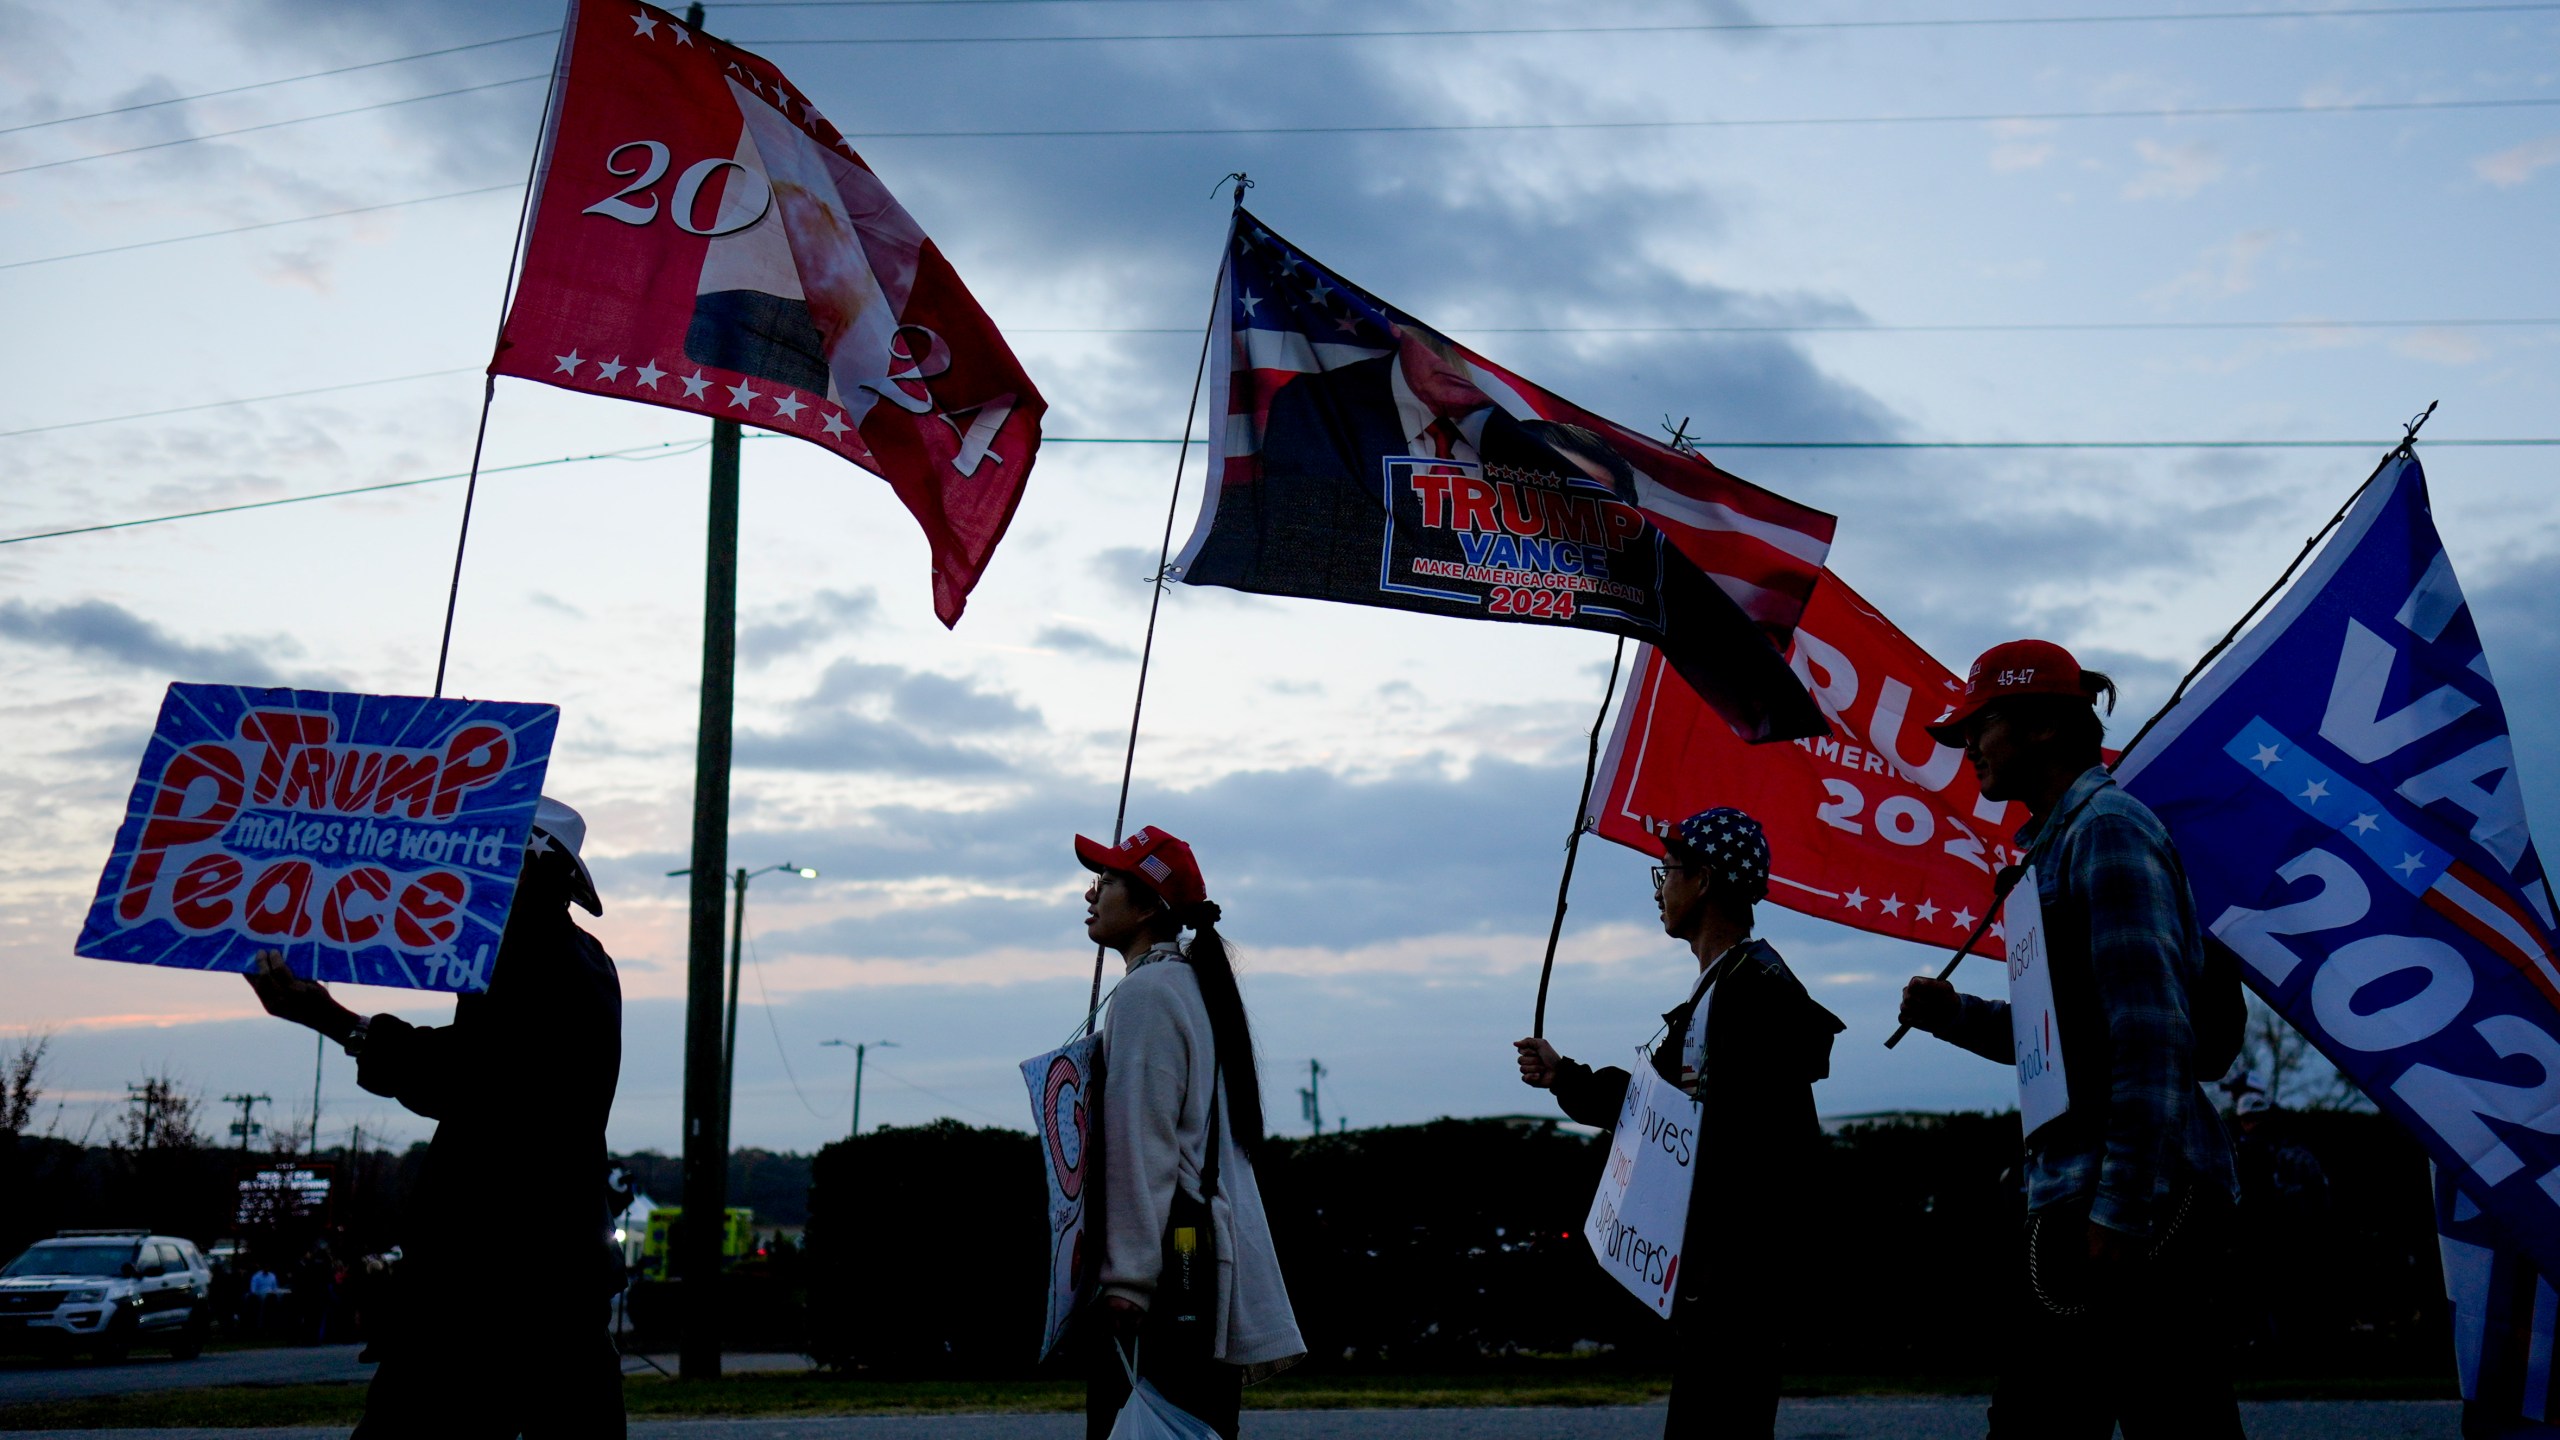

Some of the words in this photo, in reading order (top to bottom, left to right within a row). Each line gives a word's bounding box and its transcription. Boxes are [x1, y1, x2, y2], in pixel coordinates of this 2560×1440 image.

[582, 140, 771, 237] 20
[1411, 474, 1645, 551] TRUMP
[1413, 558, 1465, 578] MAKE
[1465, 567, 1544, 588] AMERICA
[1542, 573, 1601, 593] GREAT
[1599, 582, 1645, 604] AGAIN
[1458, 532, 1609, 578] VANCE
[1488, 588, 1577, 619] 2024
[1997, 668, 2035, 687] 45-47
[234, 811, 353, 854] makes
[348, 817, 396, 858] the
[402, 826, 506, 868] world
[1816, 778, 1991, 874] 202
[2208, 847, 2560, 1203] 202
[1638, 1079, 1693, 1168] loves
